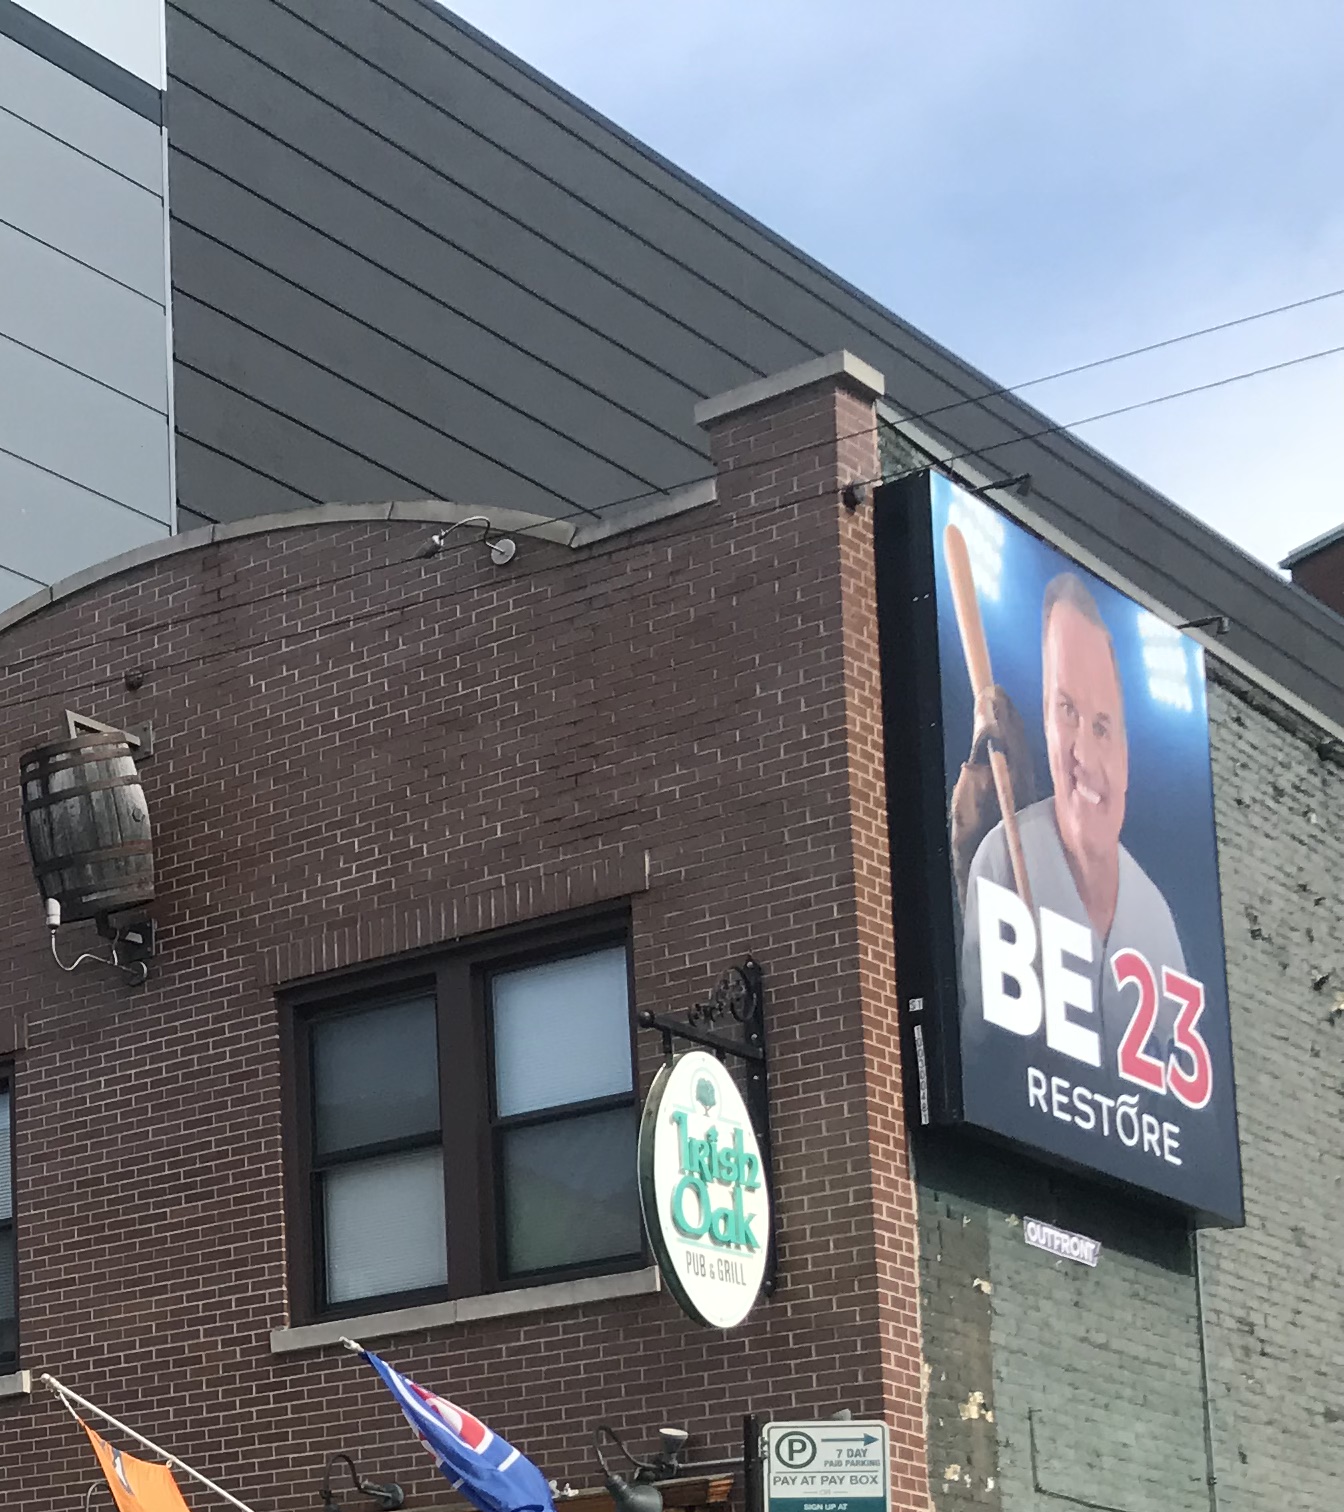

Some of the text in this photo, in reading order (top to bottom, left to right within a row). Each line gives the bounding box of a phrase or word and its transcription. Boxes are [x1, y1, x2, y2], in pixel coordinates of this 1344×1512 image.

[976, 875, 1102, 1068] BE
[1109, 946, 1214, 1111] 23
[671, 1111, 760, 1190] Irish
[670, 1175, 761, 1253] Oak
[1025, 1219, 1097, 1262] OUTFRONT
[685, 1250, 747, 1286] PUB & GRILL
[836, 1448, 868, 1458] 7 DAY
[844, 1459, 881, 1467] PARKING
[773, 1475, 879, 1486] PAY AT PAY BOX
[803, 1503, 848, 1511] SIGN UP AT
